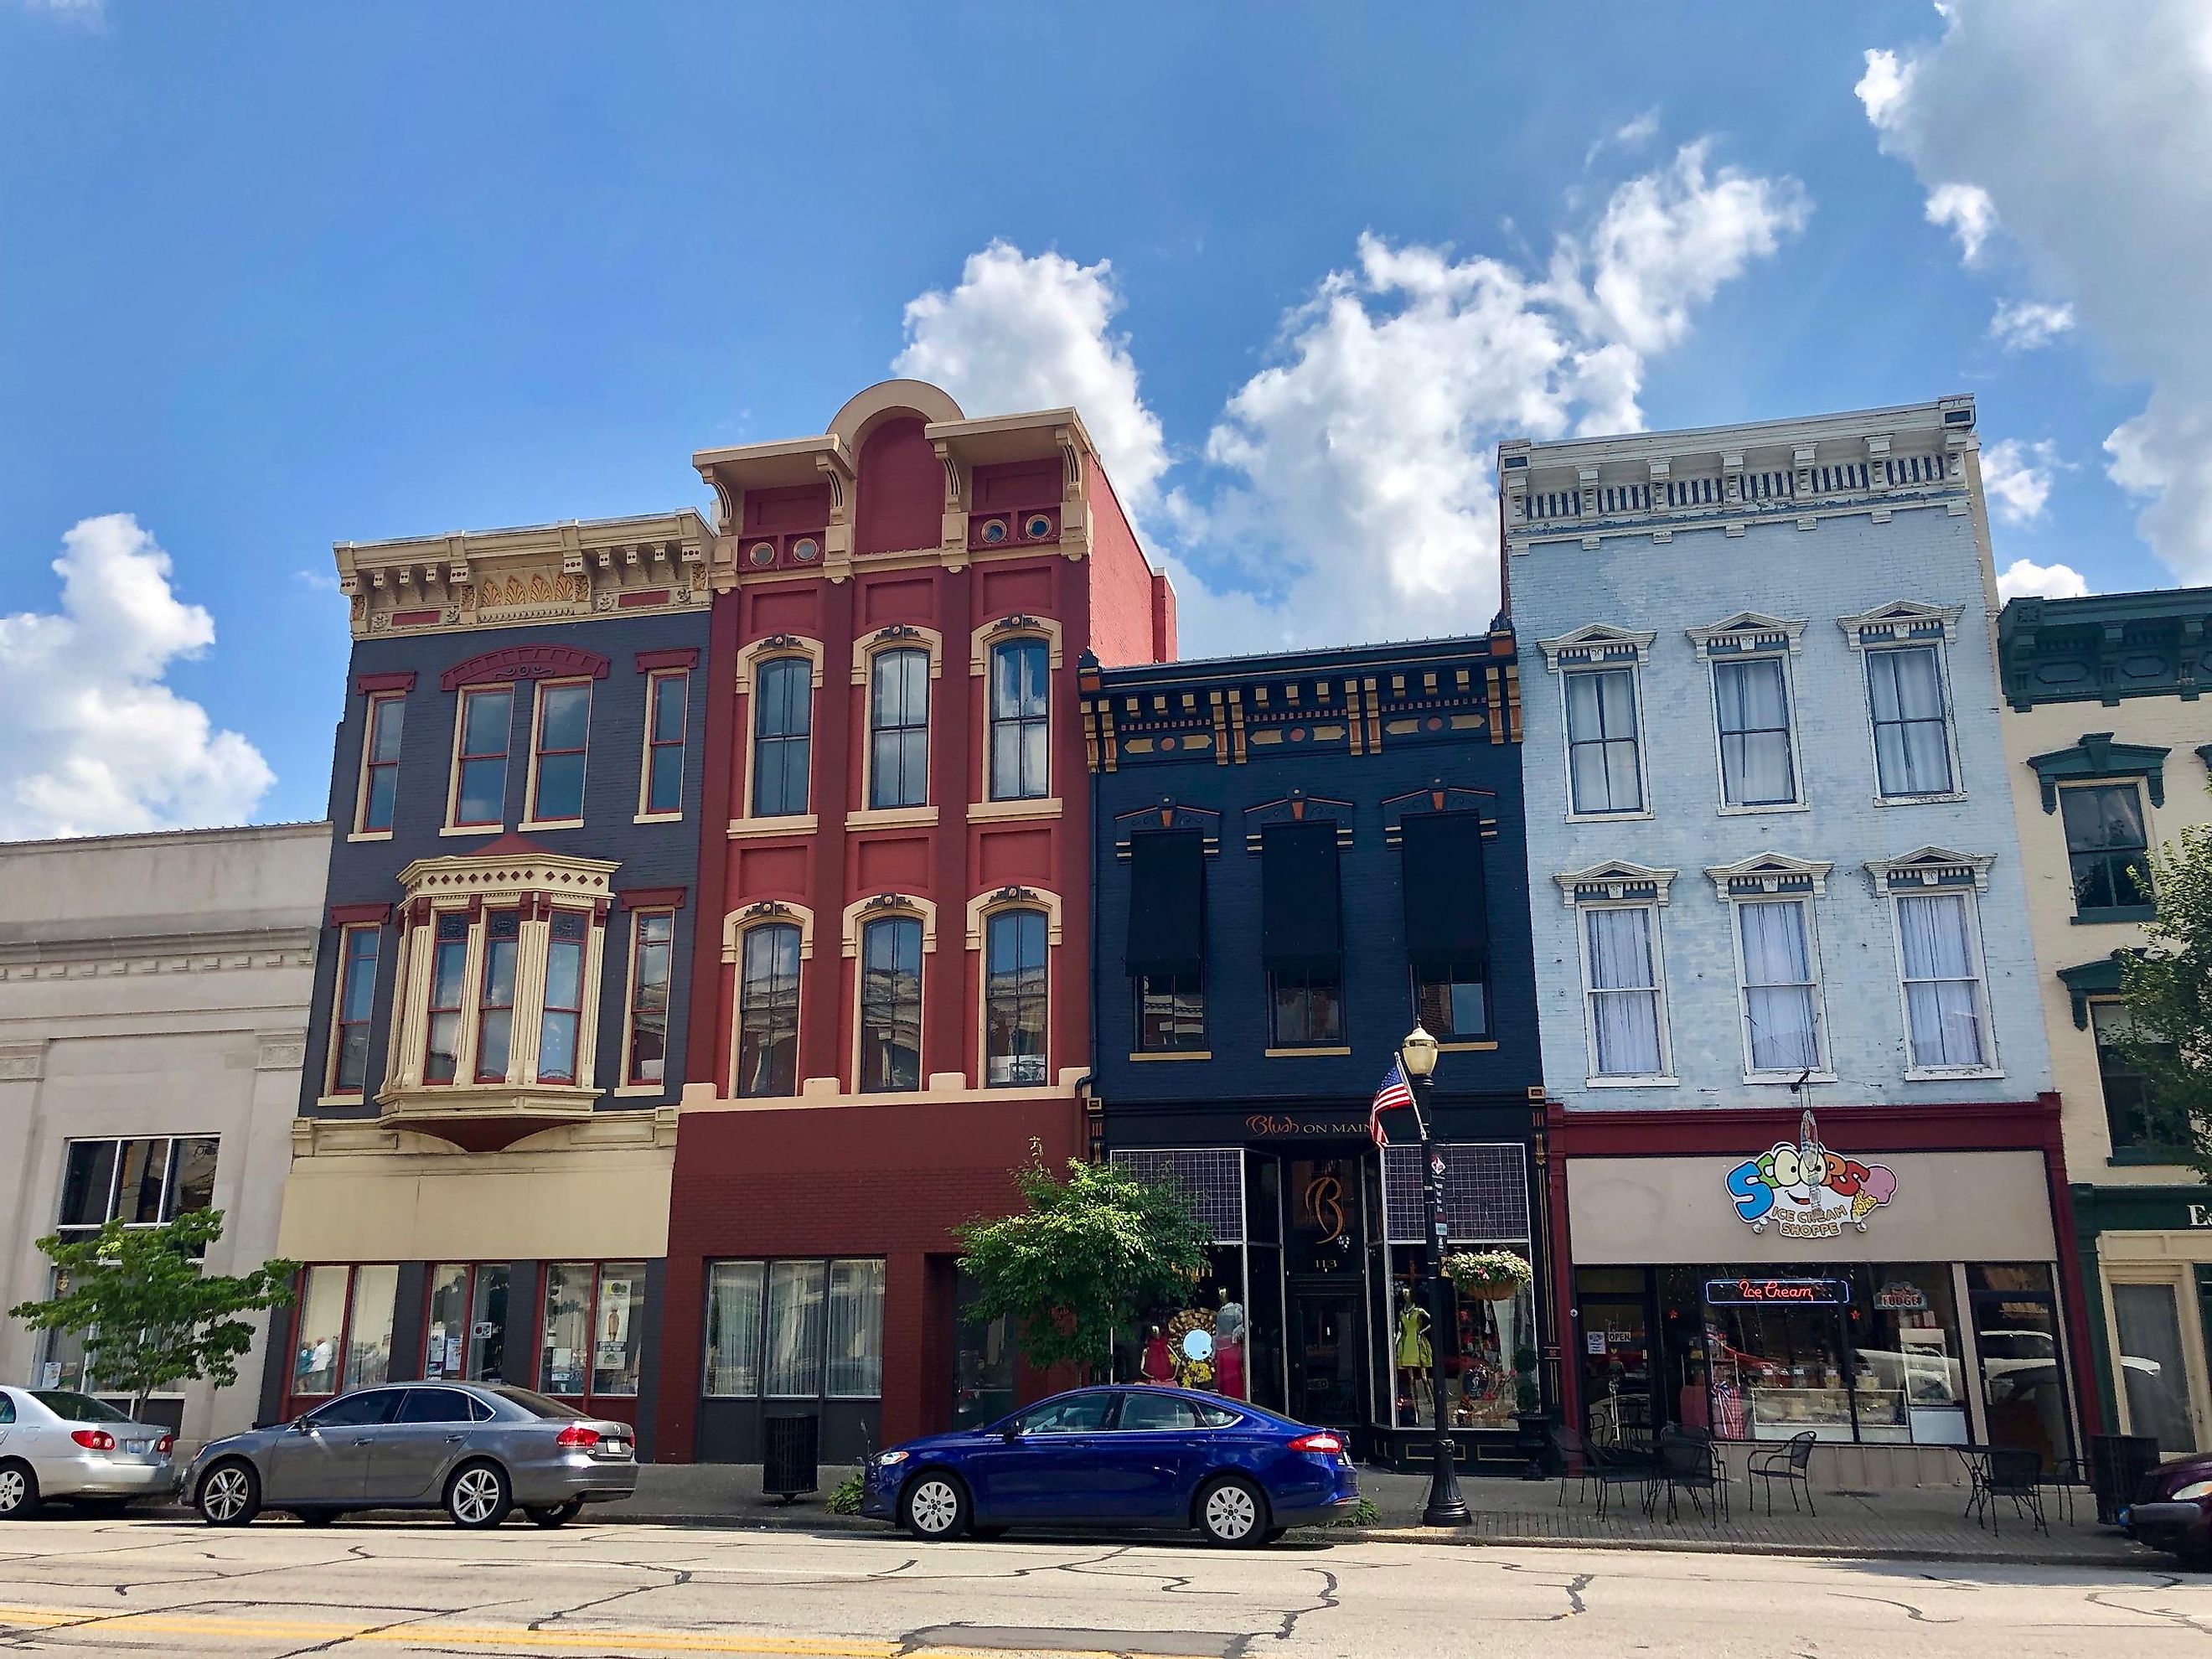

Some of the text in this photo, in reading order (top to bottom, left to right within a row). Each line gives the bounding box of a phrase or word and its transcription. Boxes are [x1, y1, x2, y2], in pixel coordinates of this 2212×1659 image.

[1245, 1115, 1300, 1136] Blush
[1304, 1124, 1327, 1134] ON
[1727, 1149, 1871, 1221] SCOOPS
[1772, 1207, 1795, 1222] ICE
[1781, 1222, 1840, 1237] SHOPPE
[1315, 1259, 1338, 1269] 113
[1739, 1280, 1813, 1302] Ice Cream
[1609, 1332, 1631, 1341] OPEN
